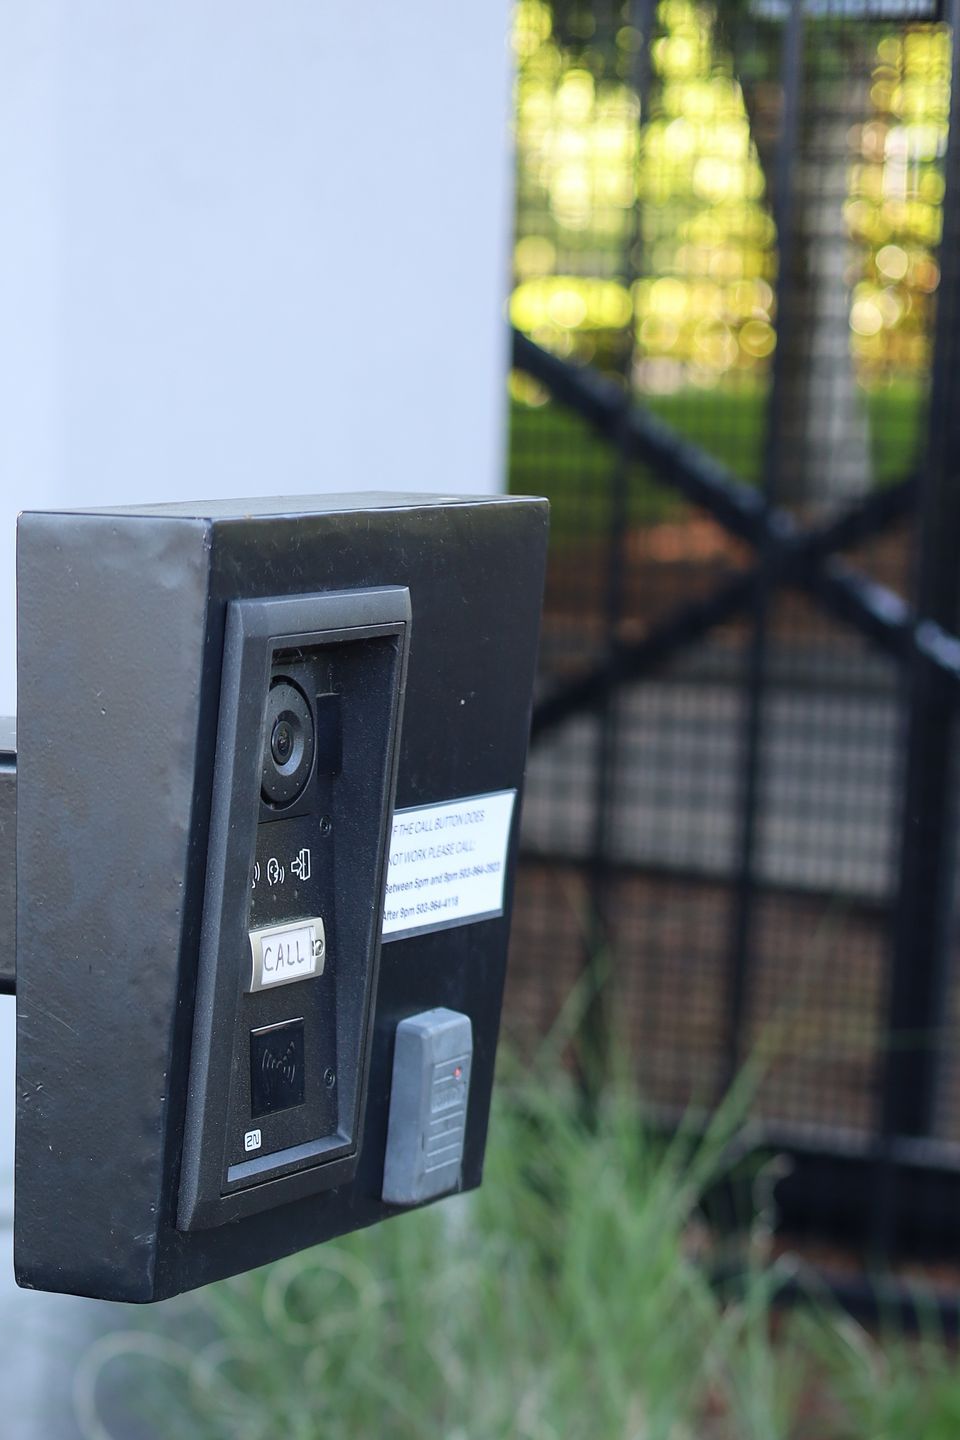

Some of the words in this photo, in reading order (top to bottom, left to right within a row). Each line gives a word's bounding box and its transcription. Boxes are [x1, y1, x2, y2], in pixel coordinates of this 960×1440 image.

[400, 823, 415, 836] THE
[415, 819, 433, 834] CALL
[435, 814, 462, 831] BUTTON
[465, 809, 485, 825] DOES
[404, 848, 426, 864] WORK
[428, 843, 455, 859] PLEASE
[430, 874, 443, 887] and
[383, 908, 399, 921] After
[264, 940, 305, 971] CALL
[246, 1133, 260, 1148] 2N
